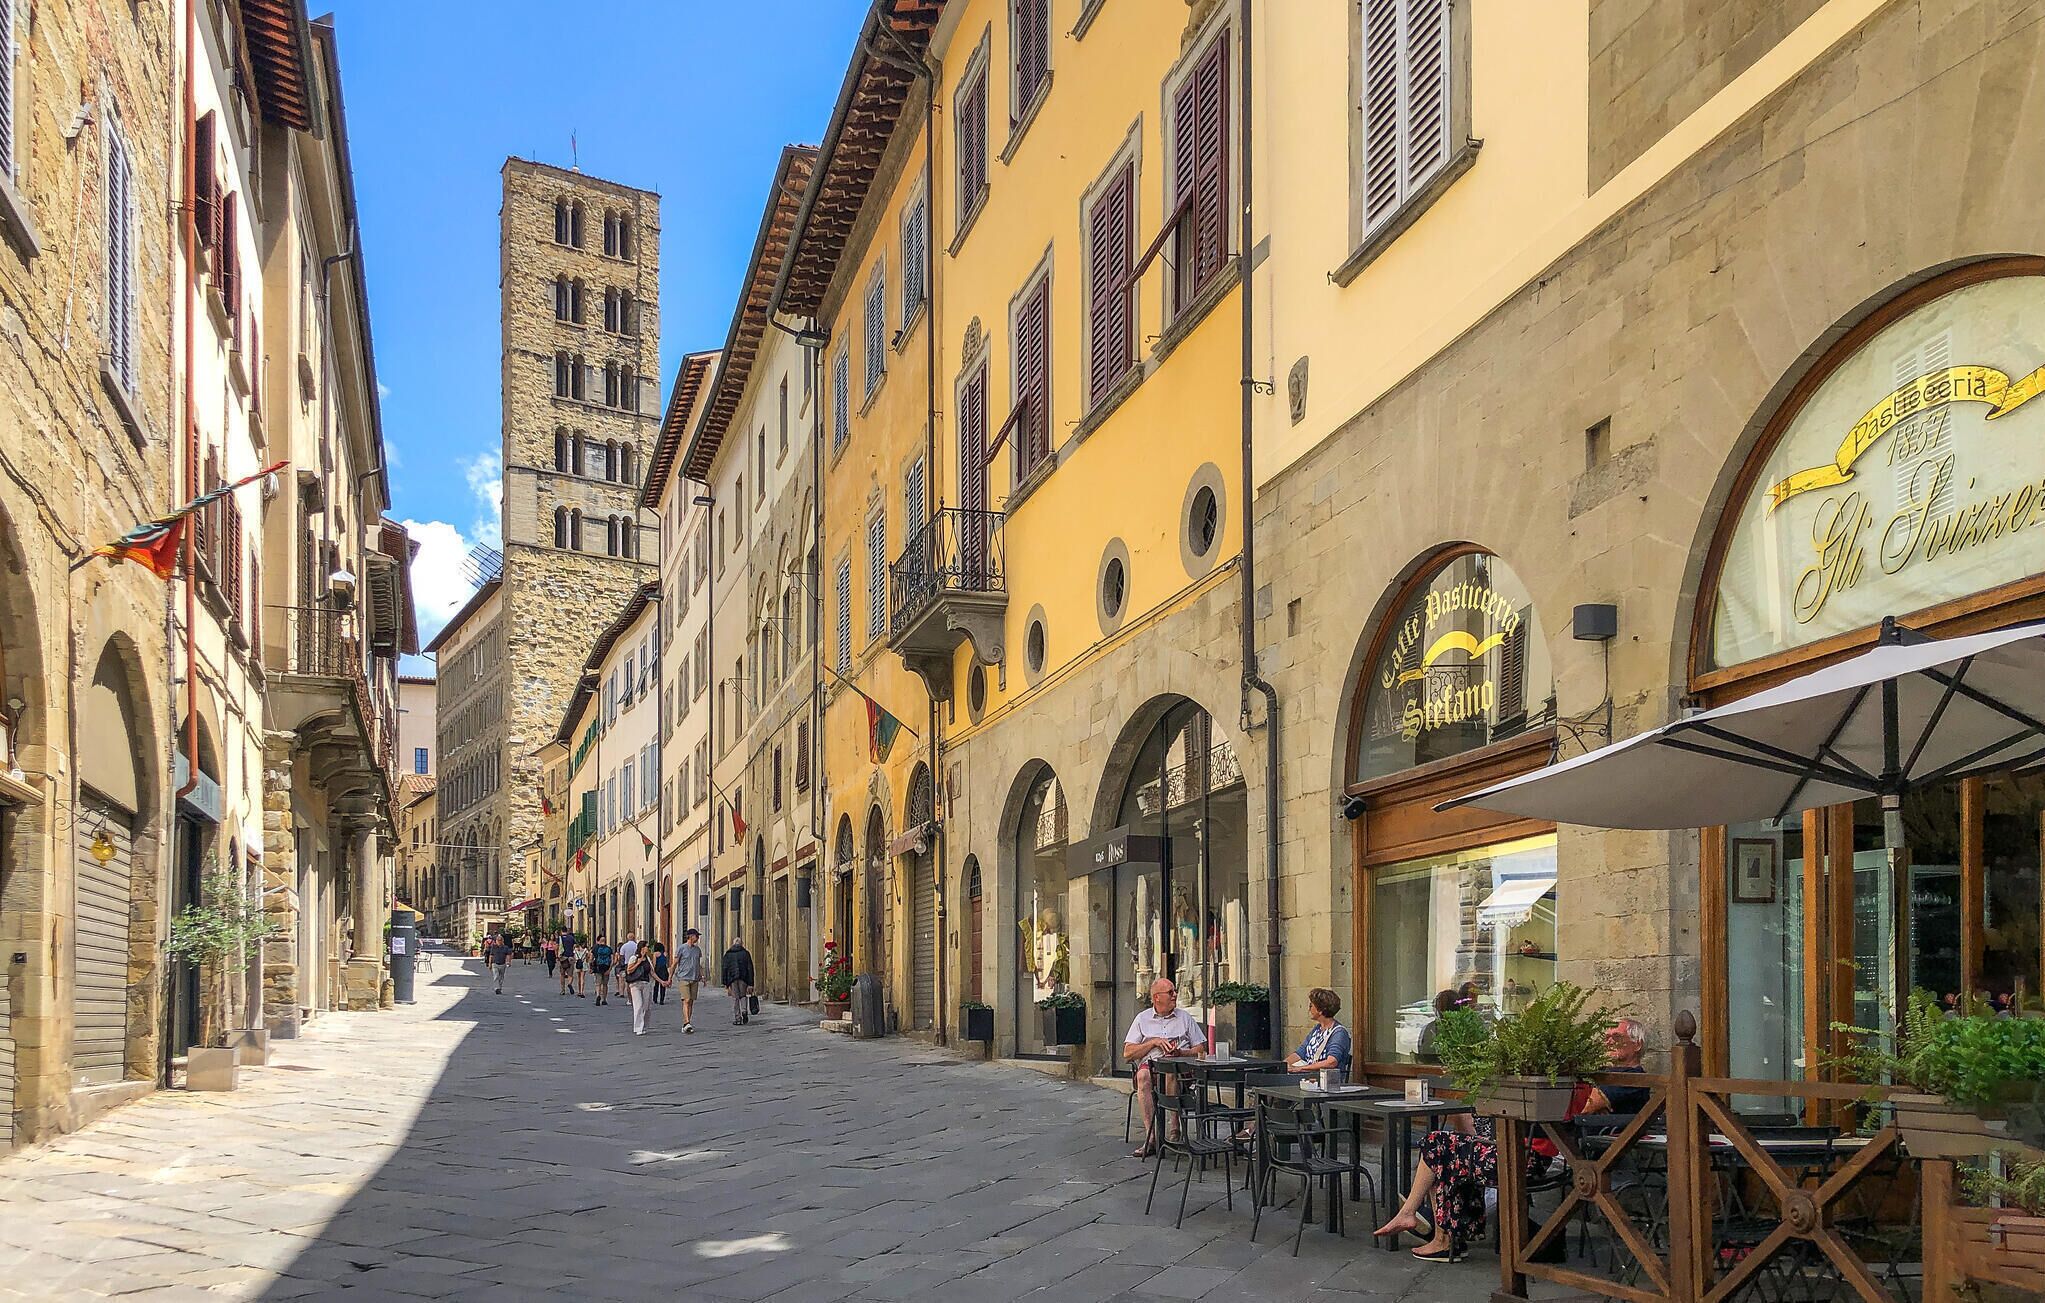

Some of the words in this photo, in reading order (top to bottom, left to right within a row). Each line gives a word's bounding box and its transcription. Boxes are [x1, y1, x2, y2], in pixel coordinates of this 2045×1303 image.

[1854, 371, 1986, 455] Pasticceria
[1887, 408, 1949, 467] 1857
[1793, 491, 1873, 624] Gli
[1425, 577, 1521, 637] Pasticceria
[1401, 679, 1494, 742] Stefano
